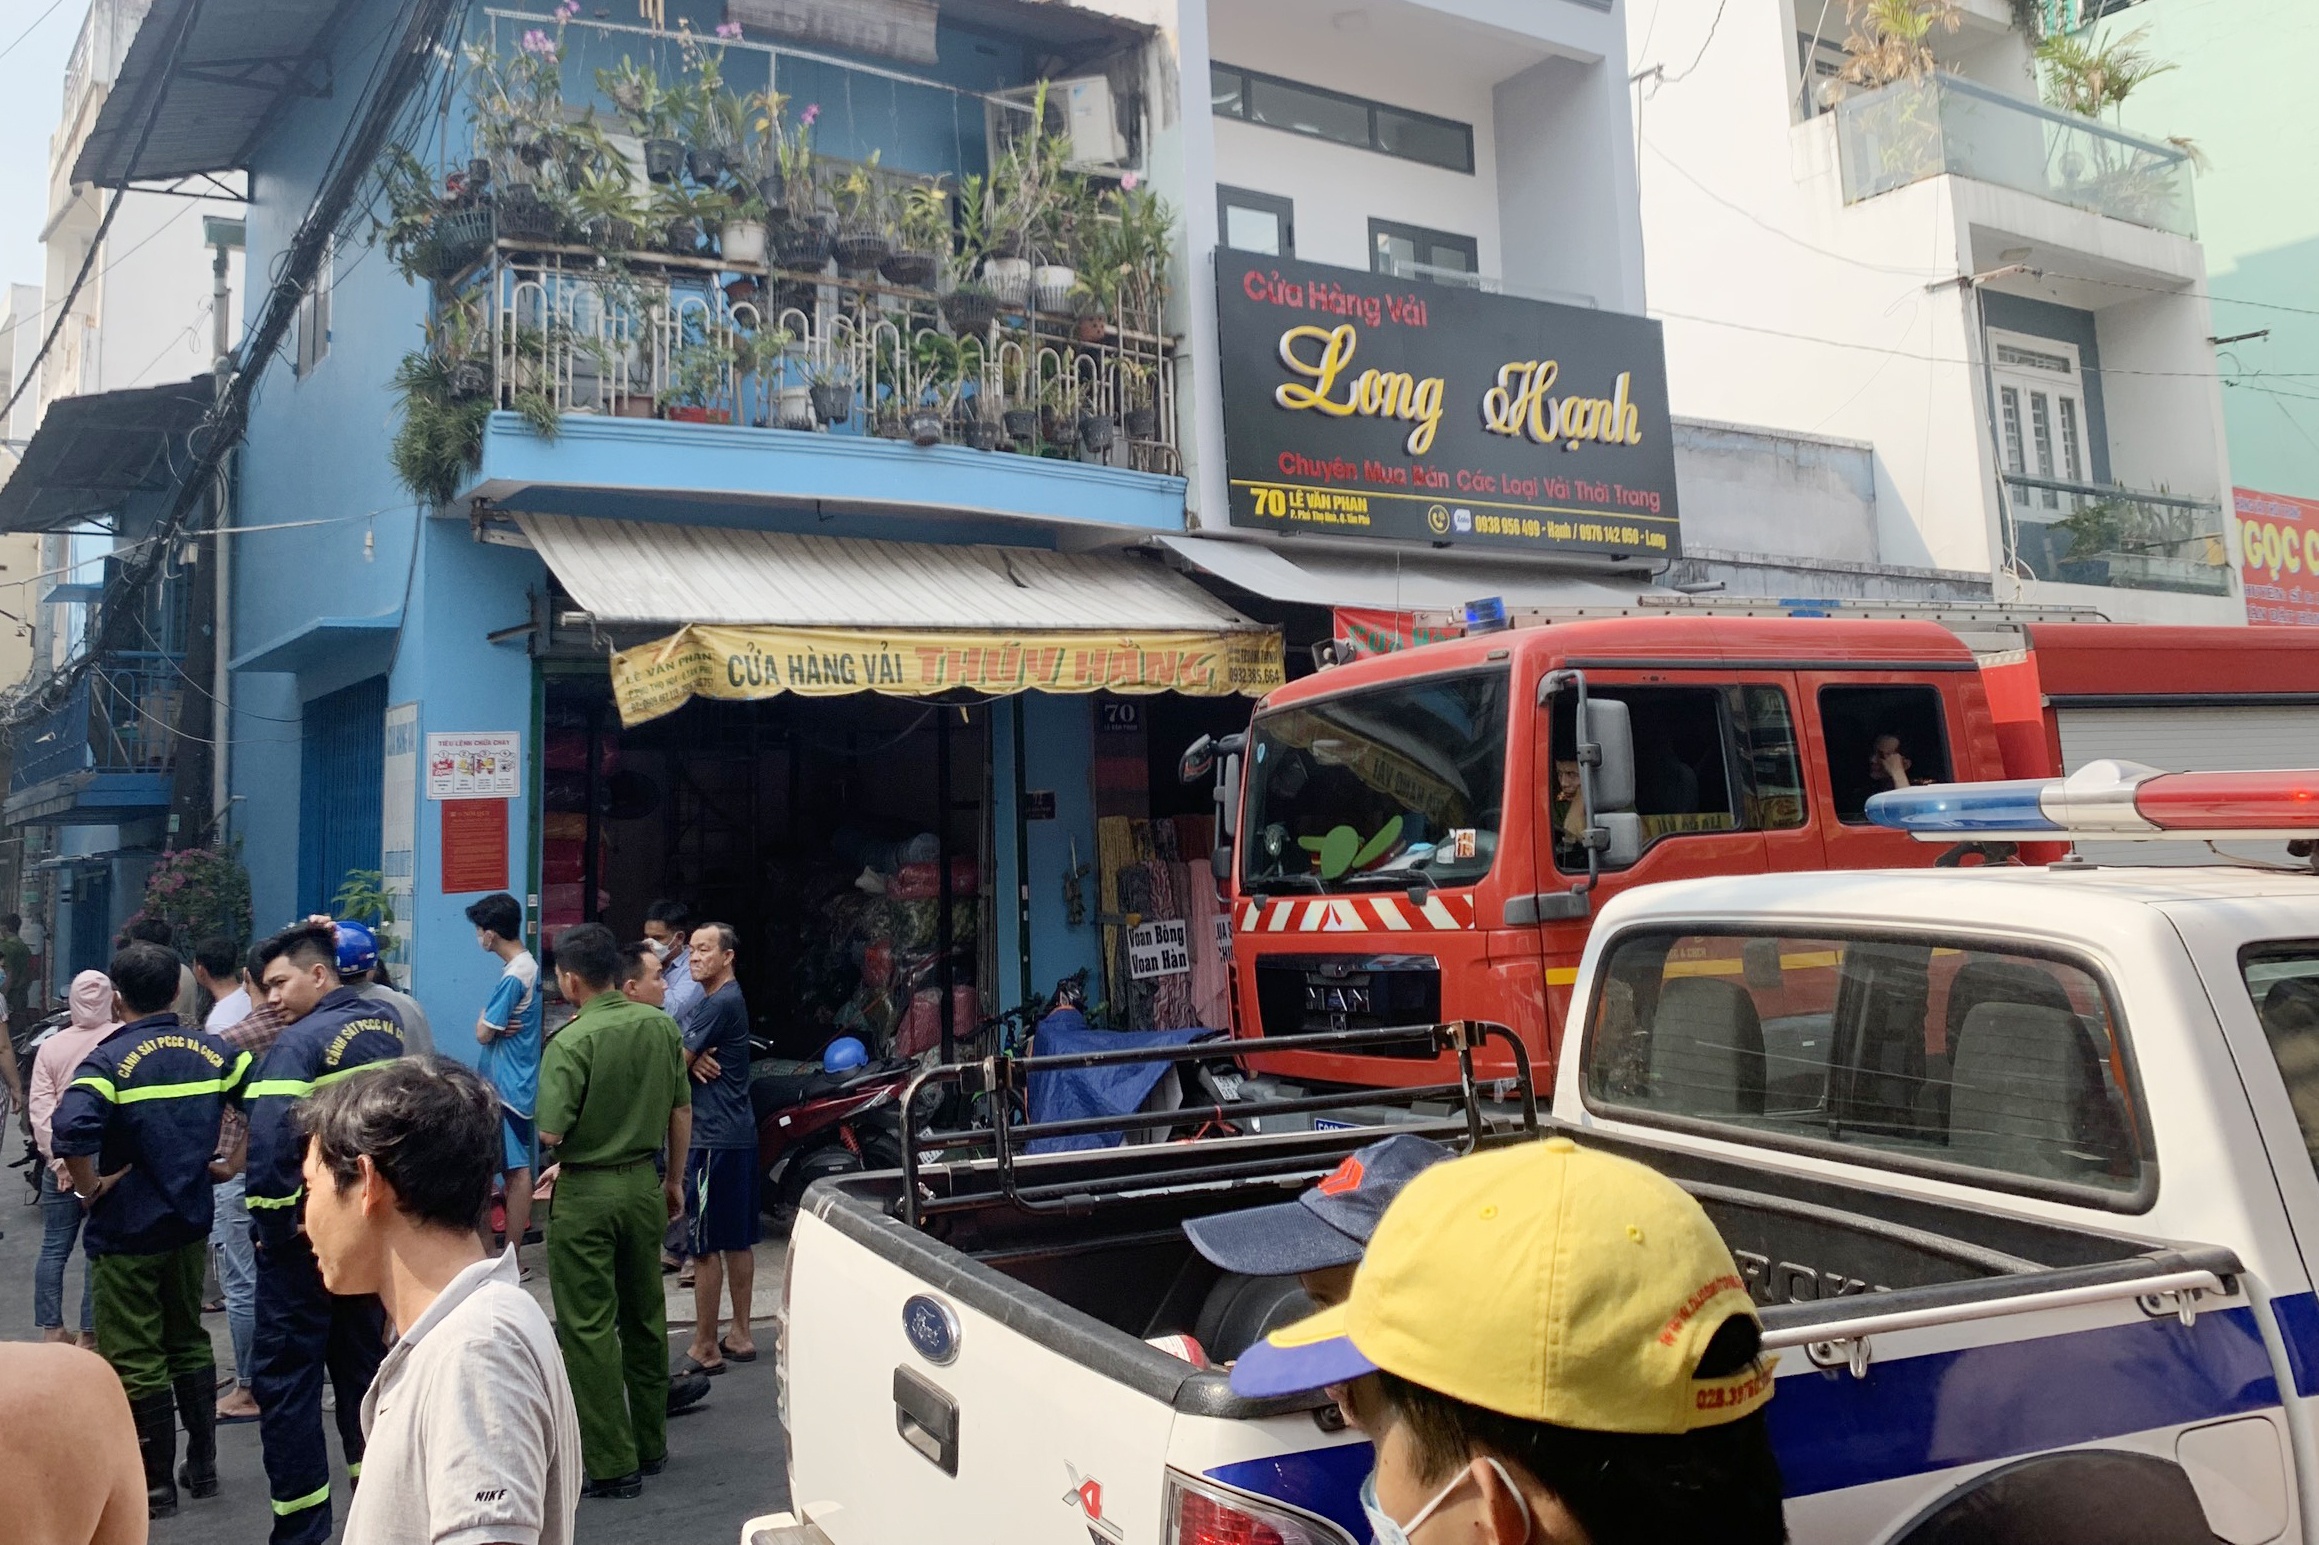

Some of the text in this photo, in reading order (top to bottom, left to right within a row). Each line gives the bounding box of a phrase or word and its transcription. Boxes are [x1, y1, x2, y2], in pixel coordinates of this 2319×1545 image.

[1243, 270, 1428, 327] Cửa Hàng Vải
[1275, 323, 1642, 456] Long Hạnh
[1278, 451, 1661, 513] Chuyên Mua Bán Các Loại Vải Thời Trang
[1250, 487, 1369, 517] 70 LÊ VĂN PHAN
[1475, 515, 1500, 534] 0938
[1521, 519, 1540, 538] 499
[1645, 529, 1667, 550] Long
[678, 652, 712, 667] PHAN
[727, 641, 781, 688] CỬA
[788, 645, 857, 685] HÀNG
[862, 640, 904, 685] VẢI
[915, 640, 1065, 686] THÚY
[1104, 704, 1135, 722] 70
[1128, 924, 1185, 948] Voan Bông
[1131, 948, 1187, 974] Voan Hàn
[356, 1018, 382, 1032] PCCC
[156, 1035, 186, 1049] PCCC
[200, 1044, 225, 1068] CNCH
[911, 1305, 941, 1347] Ford
[474, 1488, 508, 1503] NIKE
